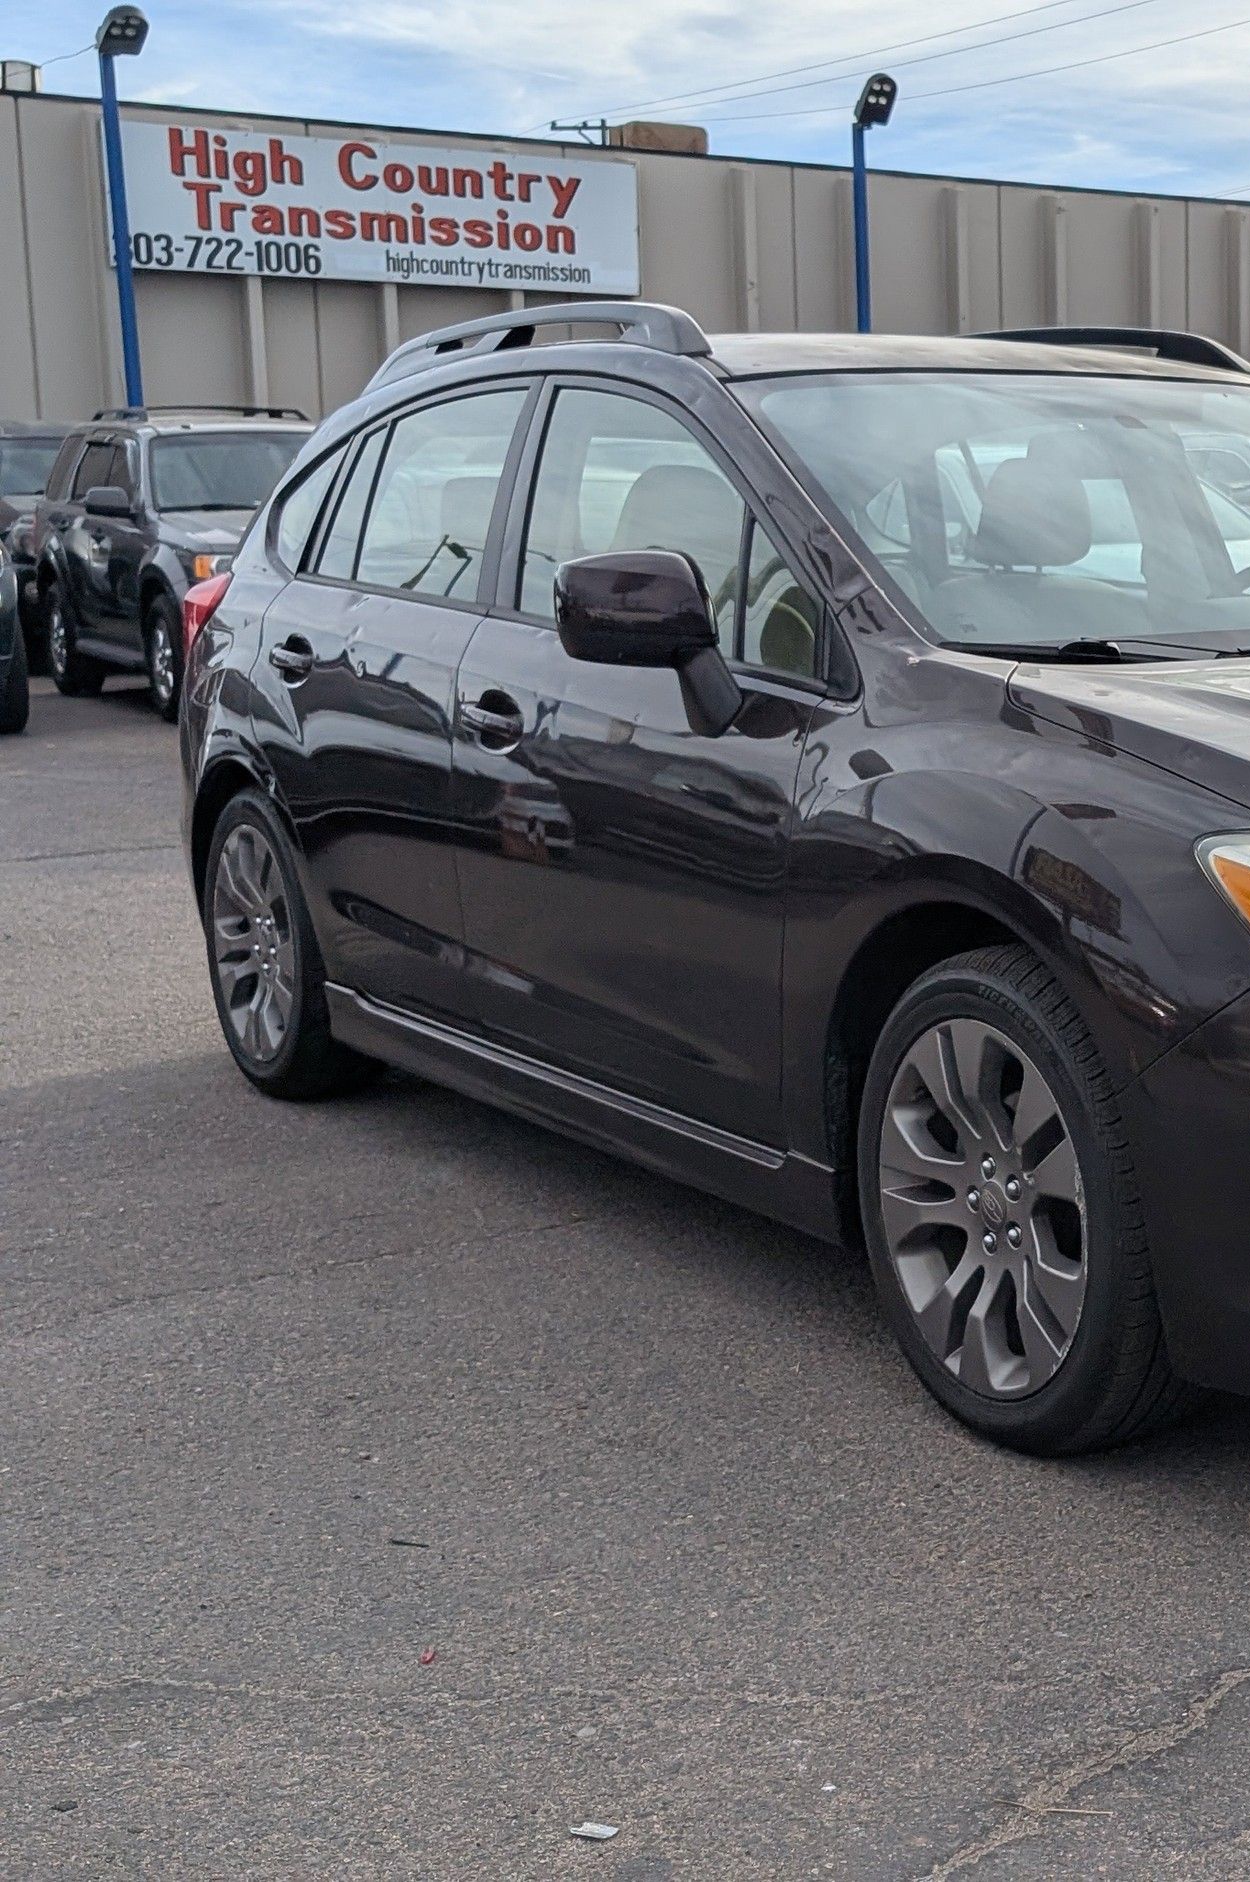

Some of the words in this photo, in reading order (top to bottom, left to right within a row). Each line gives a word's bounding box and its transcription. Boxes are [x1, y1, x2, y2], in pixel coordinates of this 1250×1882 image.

[168, 126, 304, 197] High
[337, 141, 582, 220] Country
[182, 180, 577, 256] Transmission
[113, 233, 323, 275] 03-722-1006
[386, 249, 591, 284] highcountrytransmission
